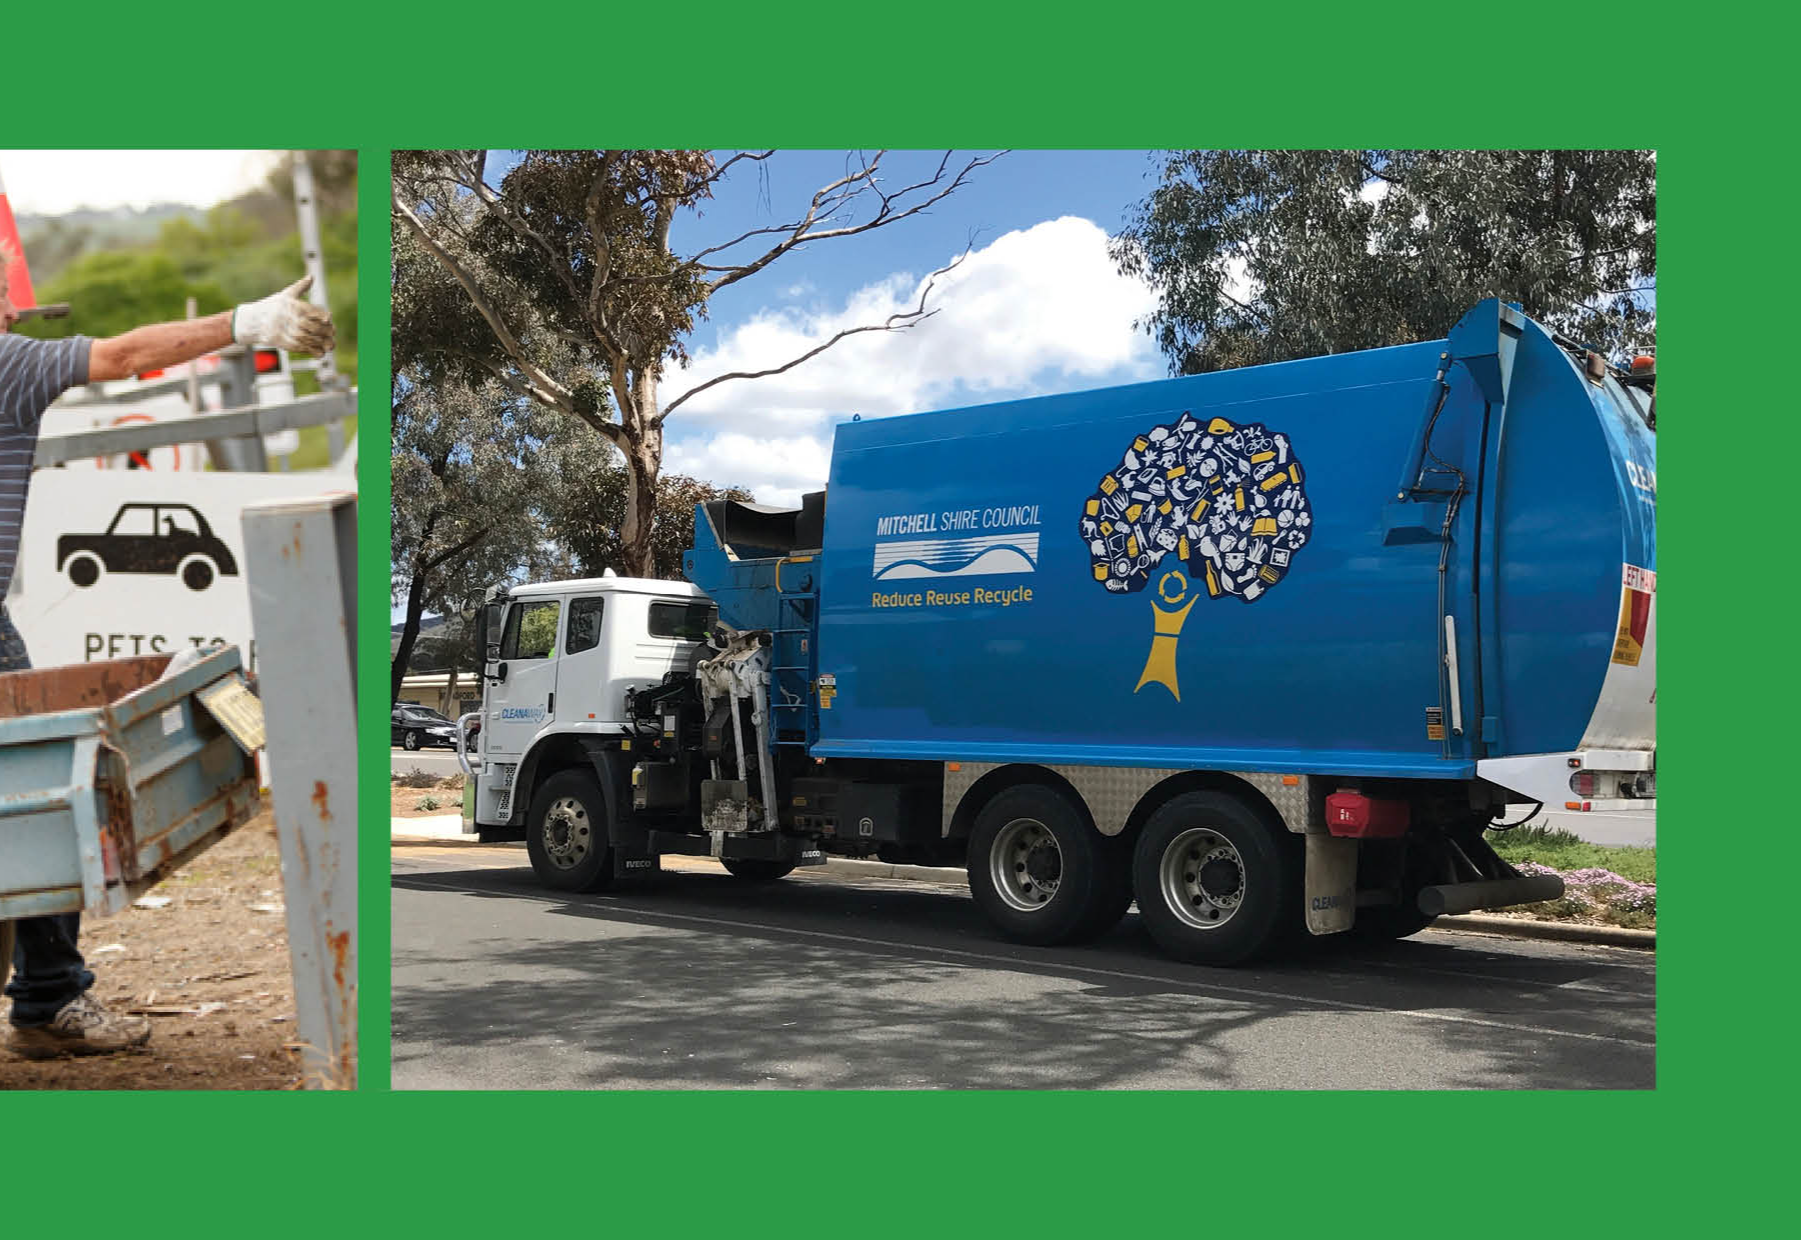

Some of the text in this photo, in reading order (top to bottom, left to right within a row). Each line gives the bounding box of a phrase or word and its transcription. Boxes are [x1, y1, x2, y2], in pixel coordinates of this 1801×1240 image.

[876, 505, 1042, 536] MITCHELL SHIRE COUNCIL
[872, 585, 1033, 608] Reduce Reuse Recycle
[85, 632, 167, 662] PETS
[501, 707, 544, 719] CLEANAWAY
[802, 850, 821, 858] IVECO
[625, 859, 652, 869] IVECO
